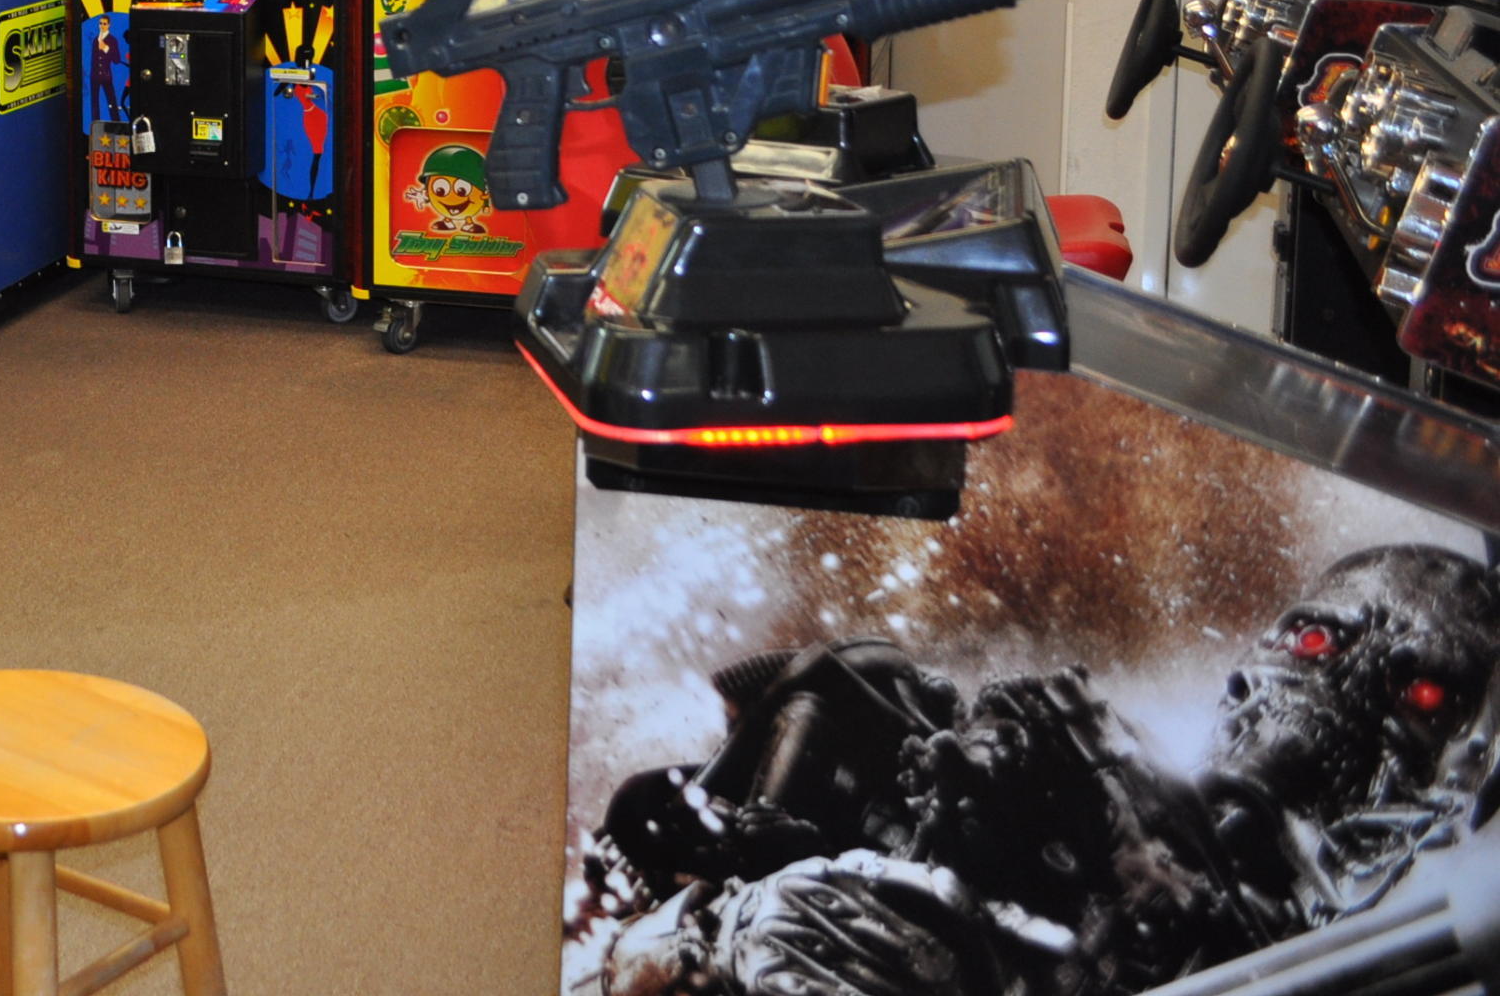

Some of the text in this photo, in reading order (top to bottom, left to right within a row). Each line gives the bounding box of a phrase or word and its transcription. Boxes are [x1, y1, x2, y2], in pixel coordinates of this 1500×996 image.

[3, 18, 67, 93] SKITT
[91, 150, 133, 169] BLIN
[97, 168, 149, 189] KING
